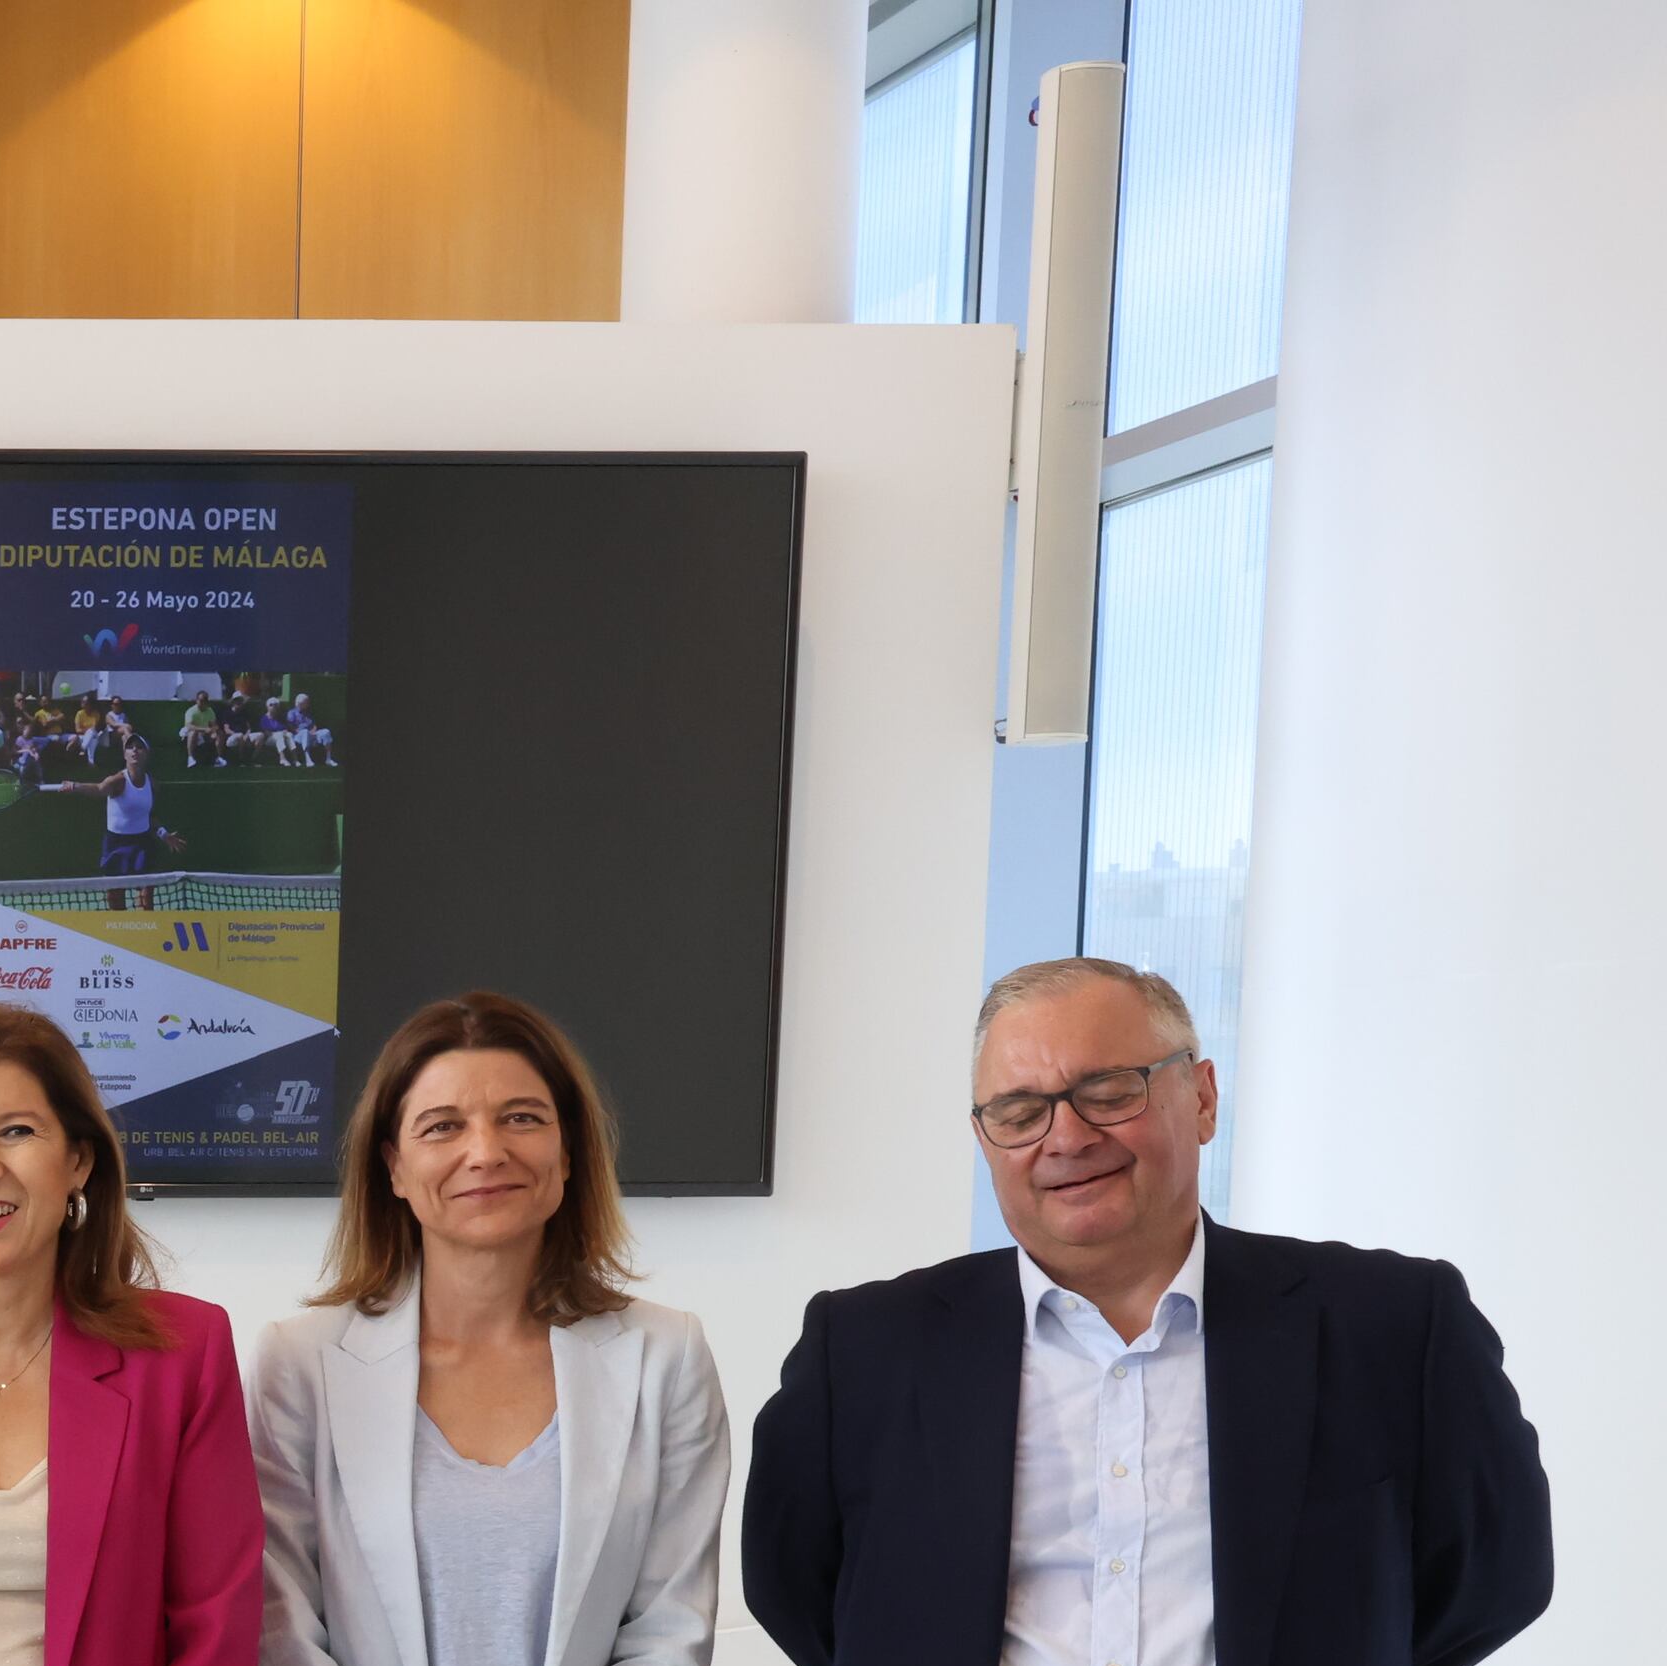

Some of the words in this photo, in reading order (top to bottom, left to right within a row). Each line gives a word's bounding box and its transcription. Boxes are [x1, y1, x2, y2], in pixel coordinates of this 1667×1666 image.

[51, 507, 196, 531] ESTEPONA
[203, 507, 277, 531] OPEN
[169, 545, 204, 568] DE
[212, 540, 328, 568] MÁLAGA
[70, 590, 95, 608] 20
[115, 590, 140, 608] 26
[146, 591, 199, 612] Mayo
[205, 591, 255, 609] 2024
[79, 976, 135, 989] BLISS
[187, 1018, 256, 1035] Andalucía
[131, 1131, 150, 1144] DE
[154, 1131, 195, 1144] TENIS
[200, 1131, 209, 1144] &
[213, 1131, 258, 1144] PADEL
[263, 1131, 319, 1144] BEL-AIR
